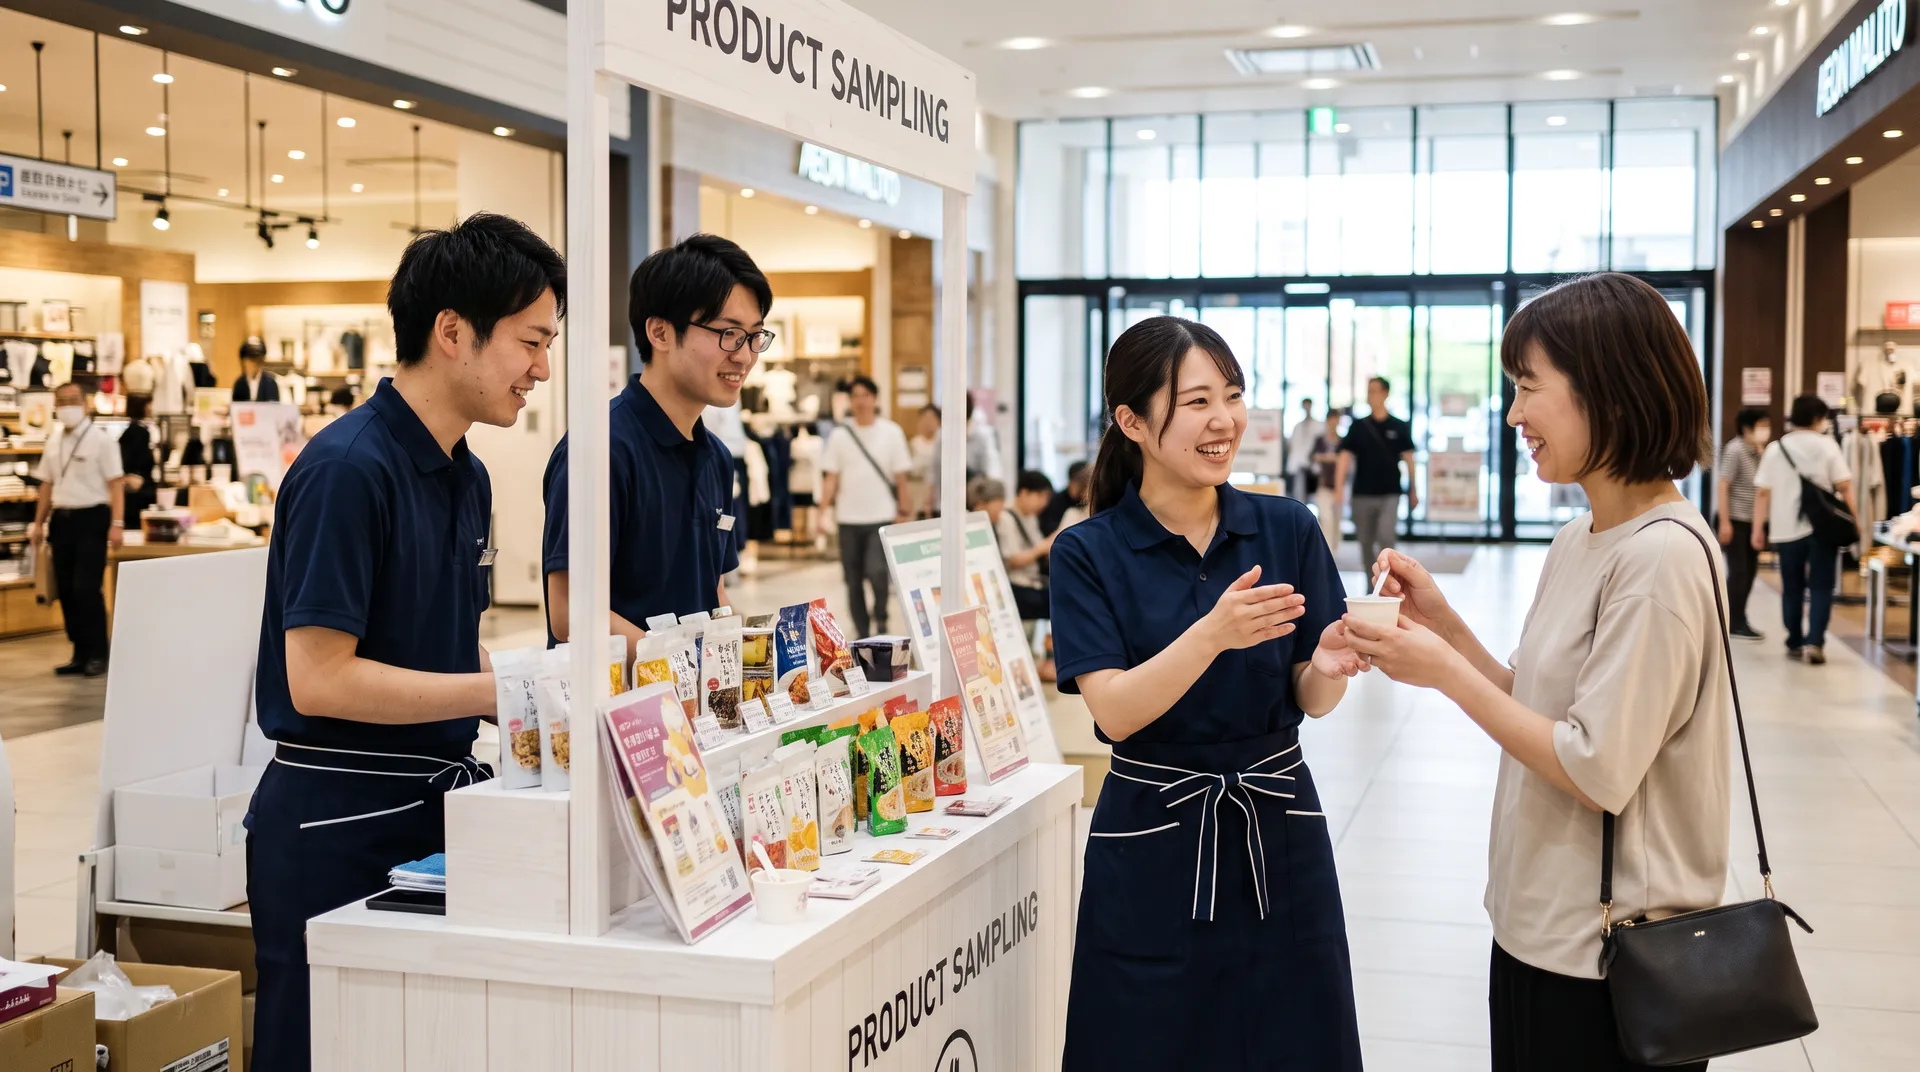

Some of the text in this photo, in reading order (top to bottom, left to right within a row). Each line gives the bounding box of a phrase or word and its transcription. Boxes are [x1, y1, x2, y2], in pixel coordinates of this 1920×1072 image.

[667, 0, 949, 144] PRODUCT SAMPLING
[849, 890, 1038, 1072] PRODUCT SAMPLING
